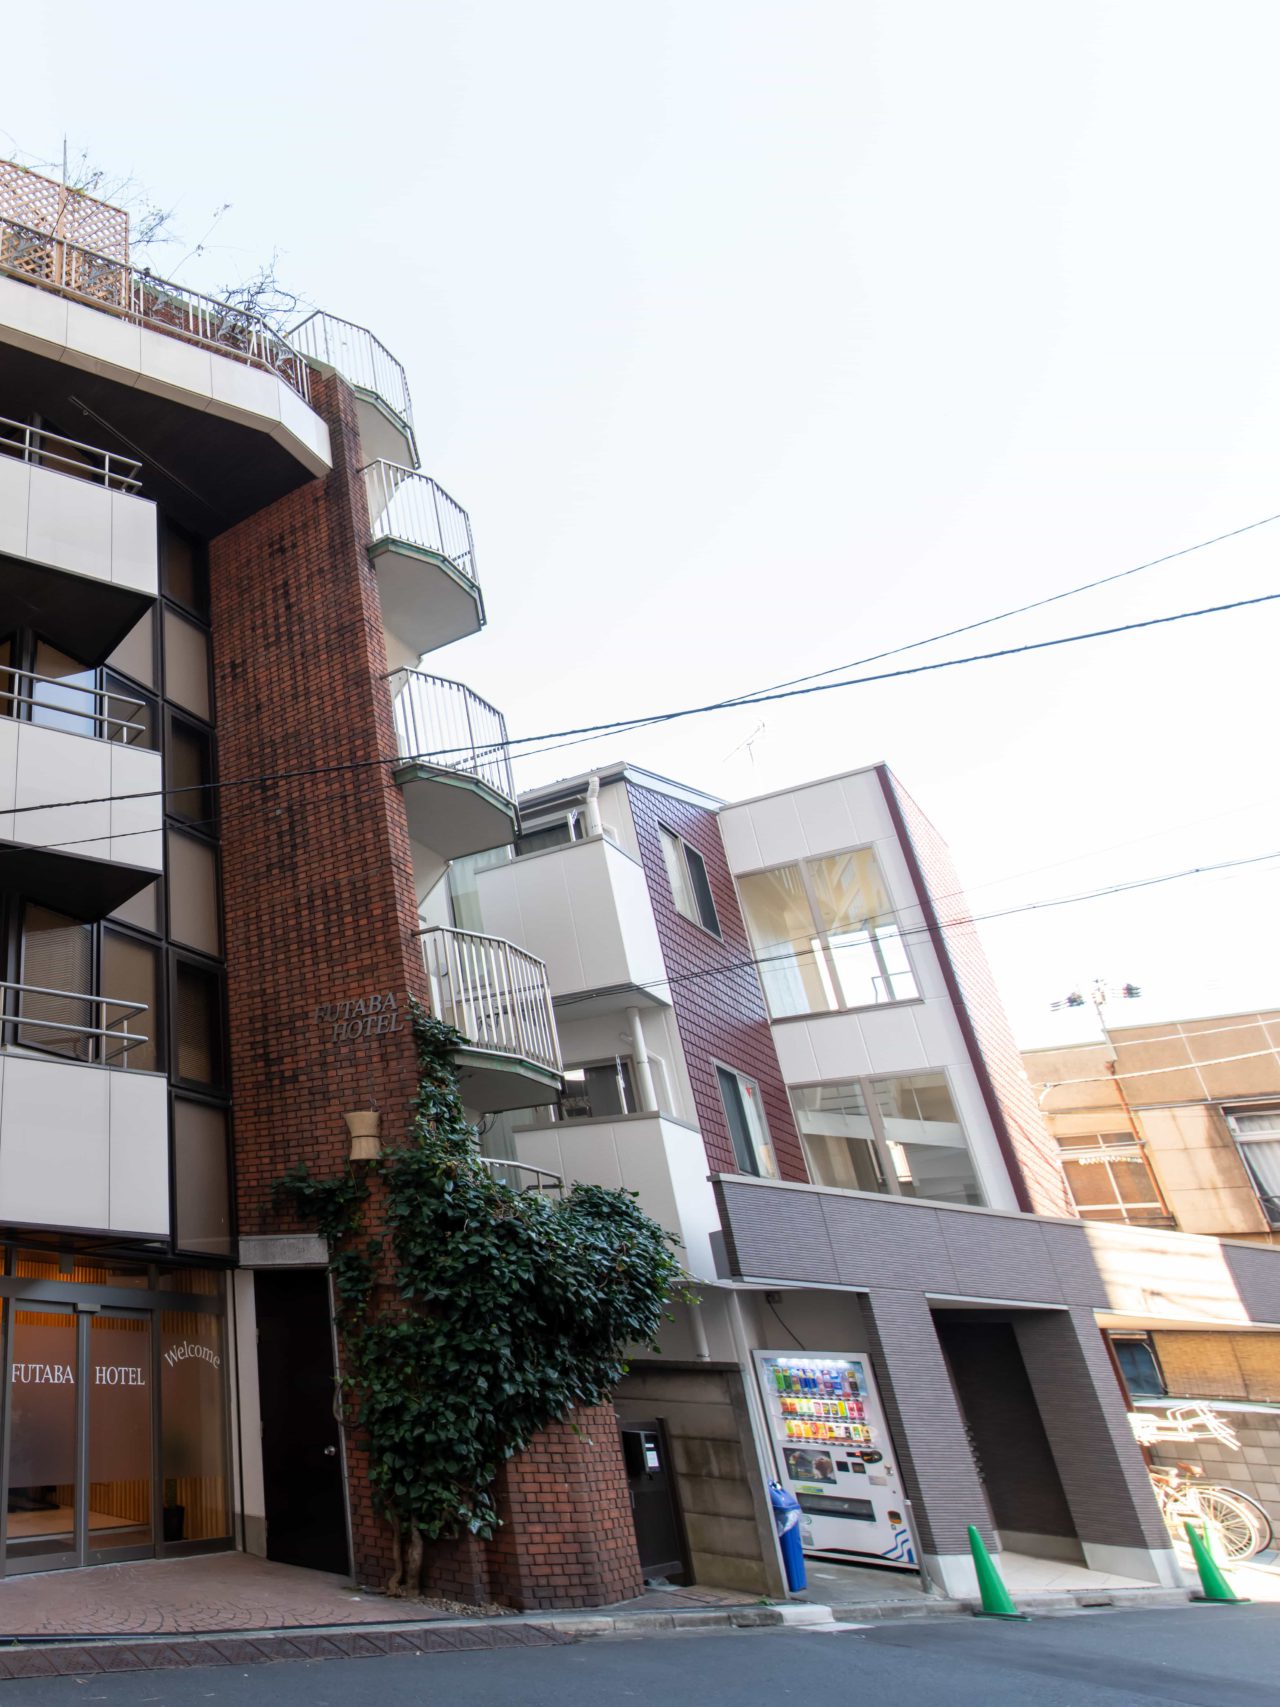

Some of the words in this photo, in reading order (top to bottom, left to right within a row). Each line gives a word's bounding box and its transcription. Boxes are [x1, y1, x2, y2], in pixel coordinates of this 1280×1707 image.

[315, 992, 398, 1024] FUTABA
[332, 1013, 404, 1042] HOTEL
[164, 1341, 220, 1369] Welcome
[11, 1363, 75, 1384] FUTABA
[95, 1366, 145, 1385] HOTEL
